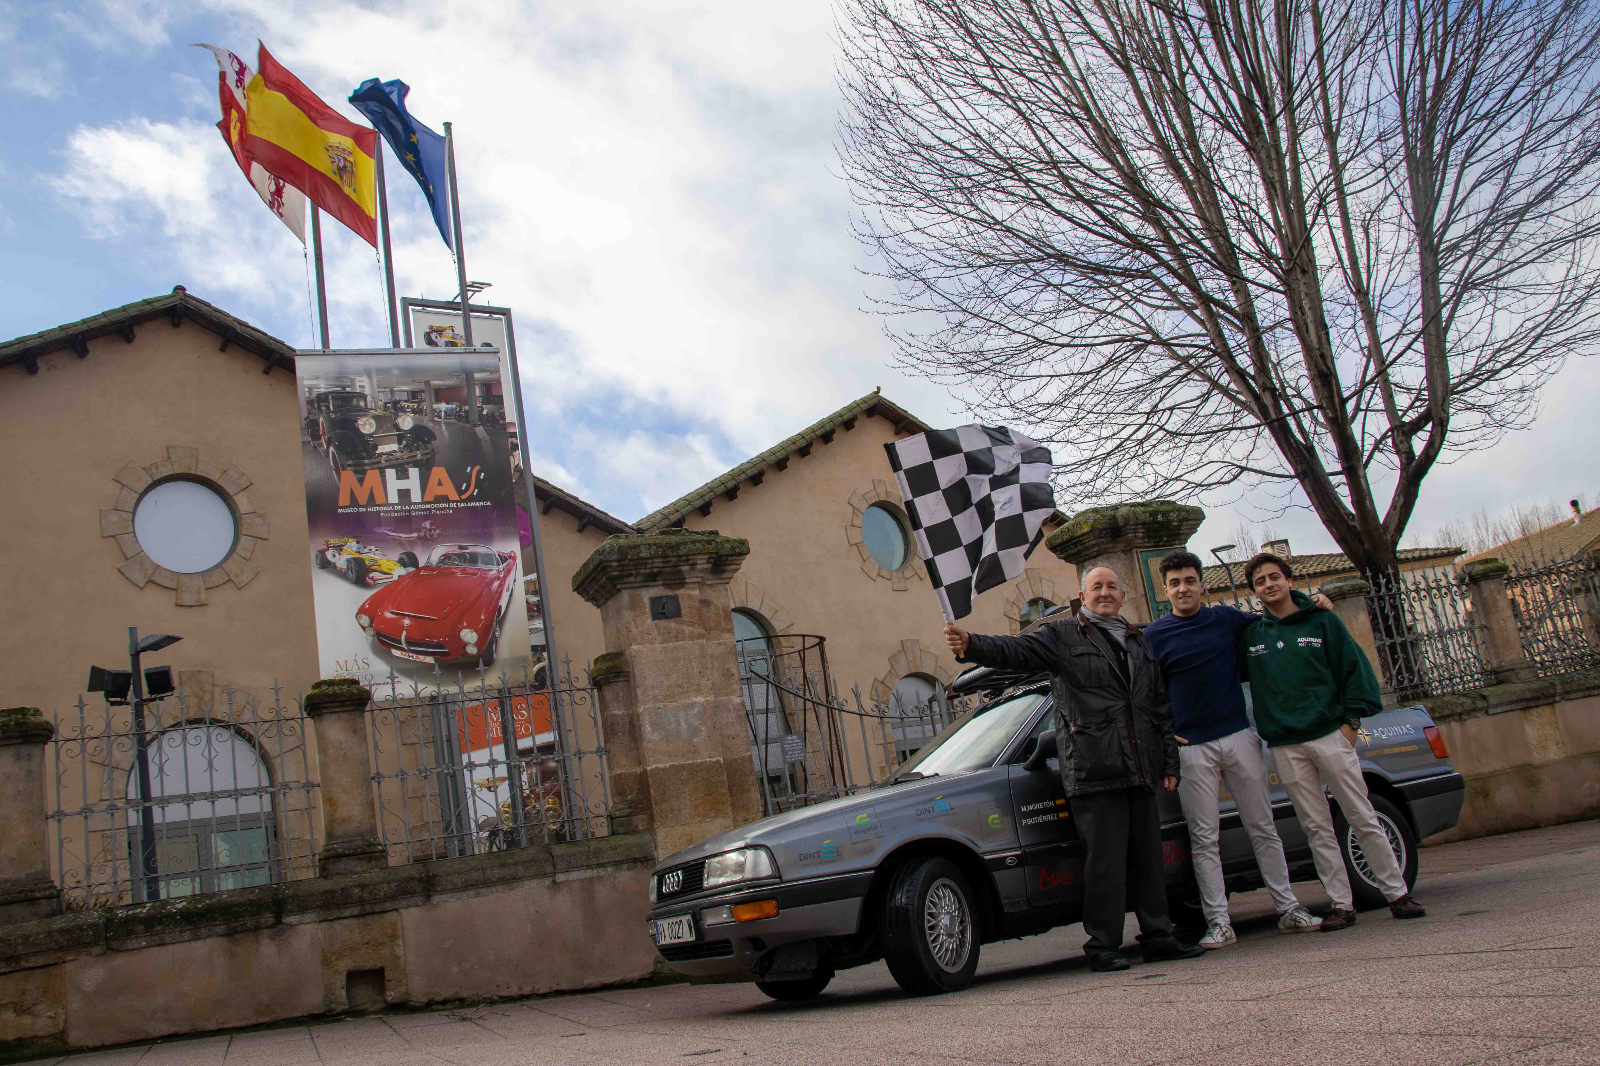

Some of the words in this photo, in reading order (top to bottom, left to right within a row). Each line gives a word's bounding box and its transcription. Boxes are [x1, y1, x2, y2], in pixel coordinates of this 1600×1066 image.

[410, 502, 449, 510] AUTOMOCIÓN
[658, 597, 670, 617] 4
[335, 652, 371, 673] MÁS
[1373, 724, 1415, 739] AQUINAS
